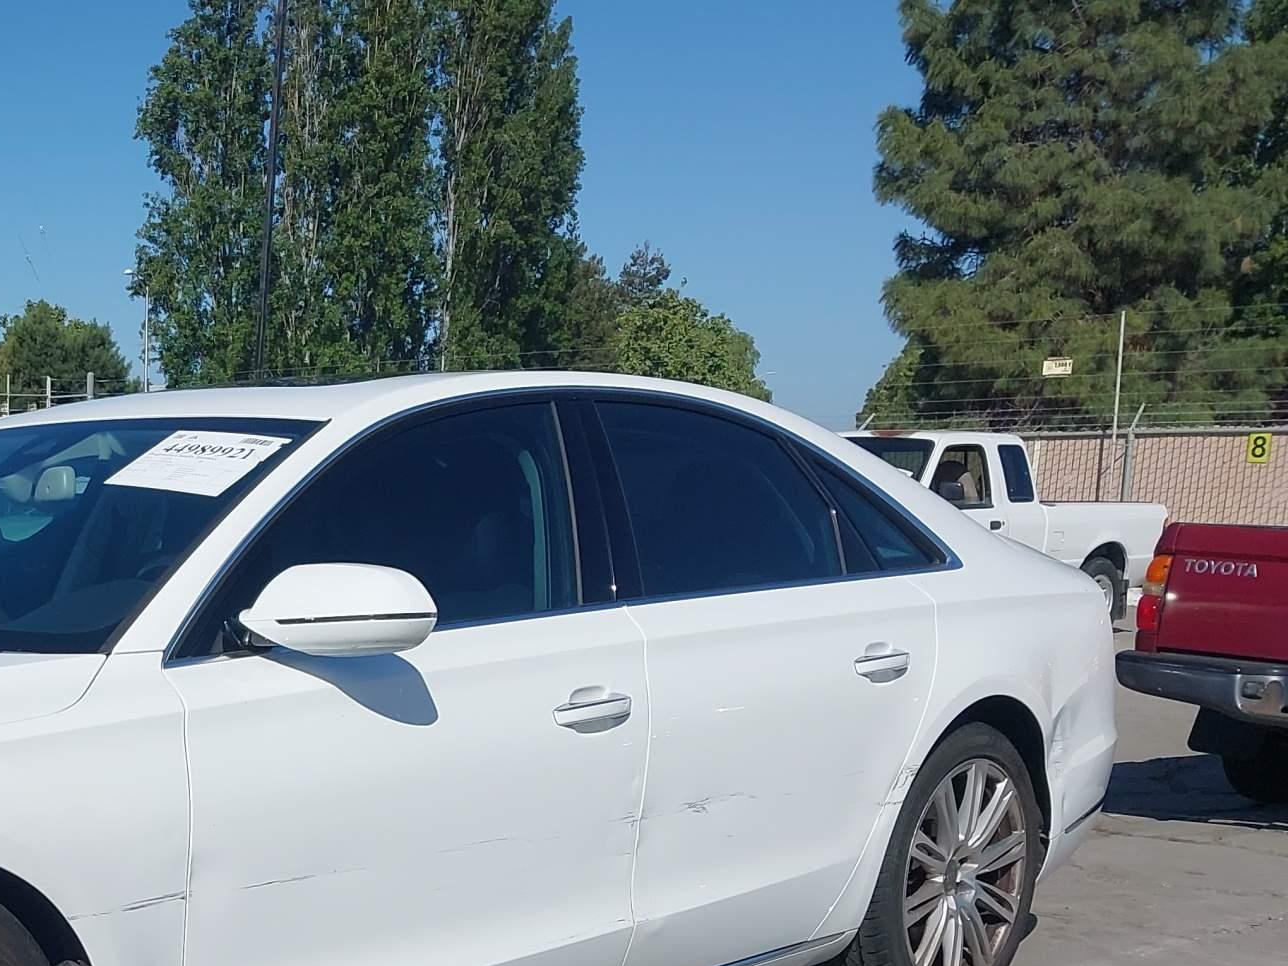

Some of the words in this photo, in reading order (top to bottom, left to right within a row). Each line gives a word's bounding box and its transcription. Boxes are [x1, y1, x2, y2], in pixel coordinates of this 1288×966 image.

[163, 443, 256, 460] 44989921
[1251, 435, 1267, 458] 8
[1184, 558, 1258, 578] TOYOTA
